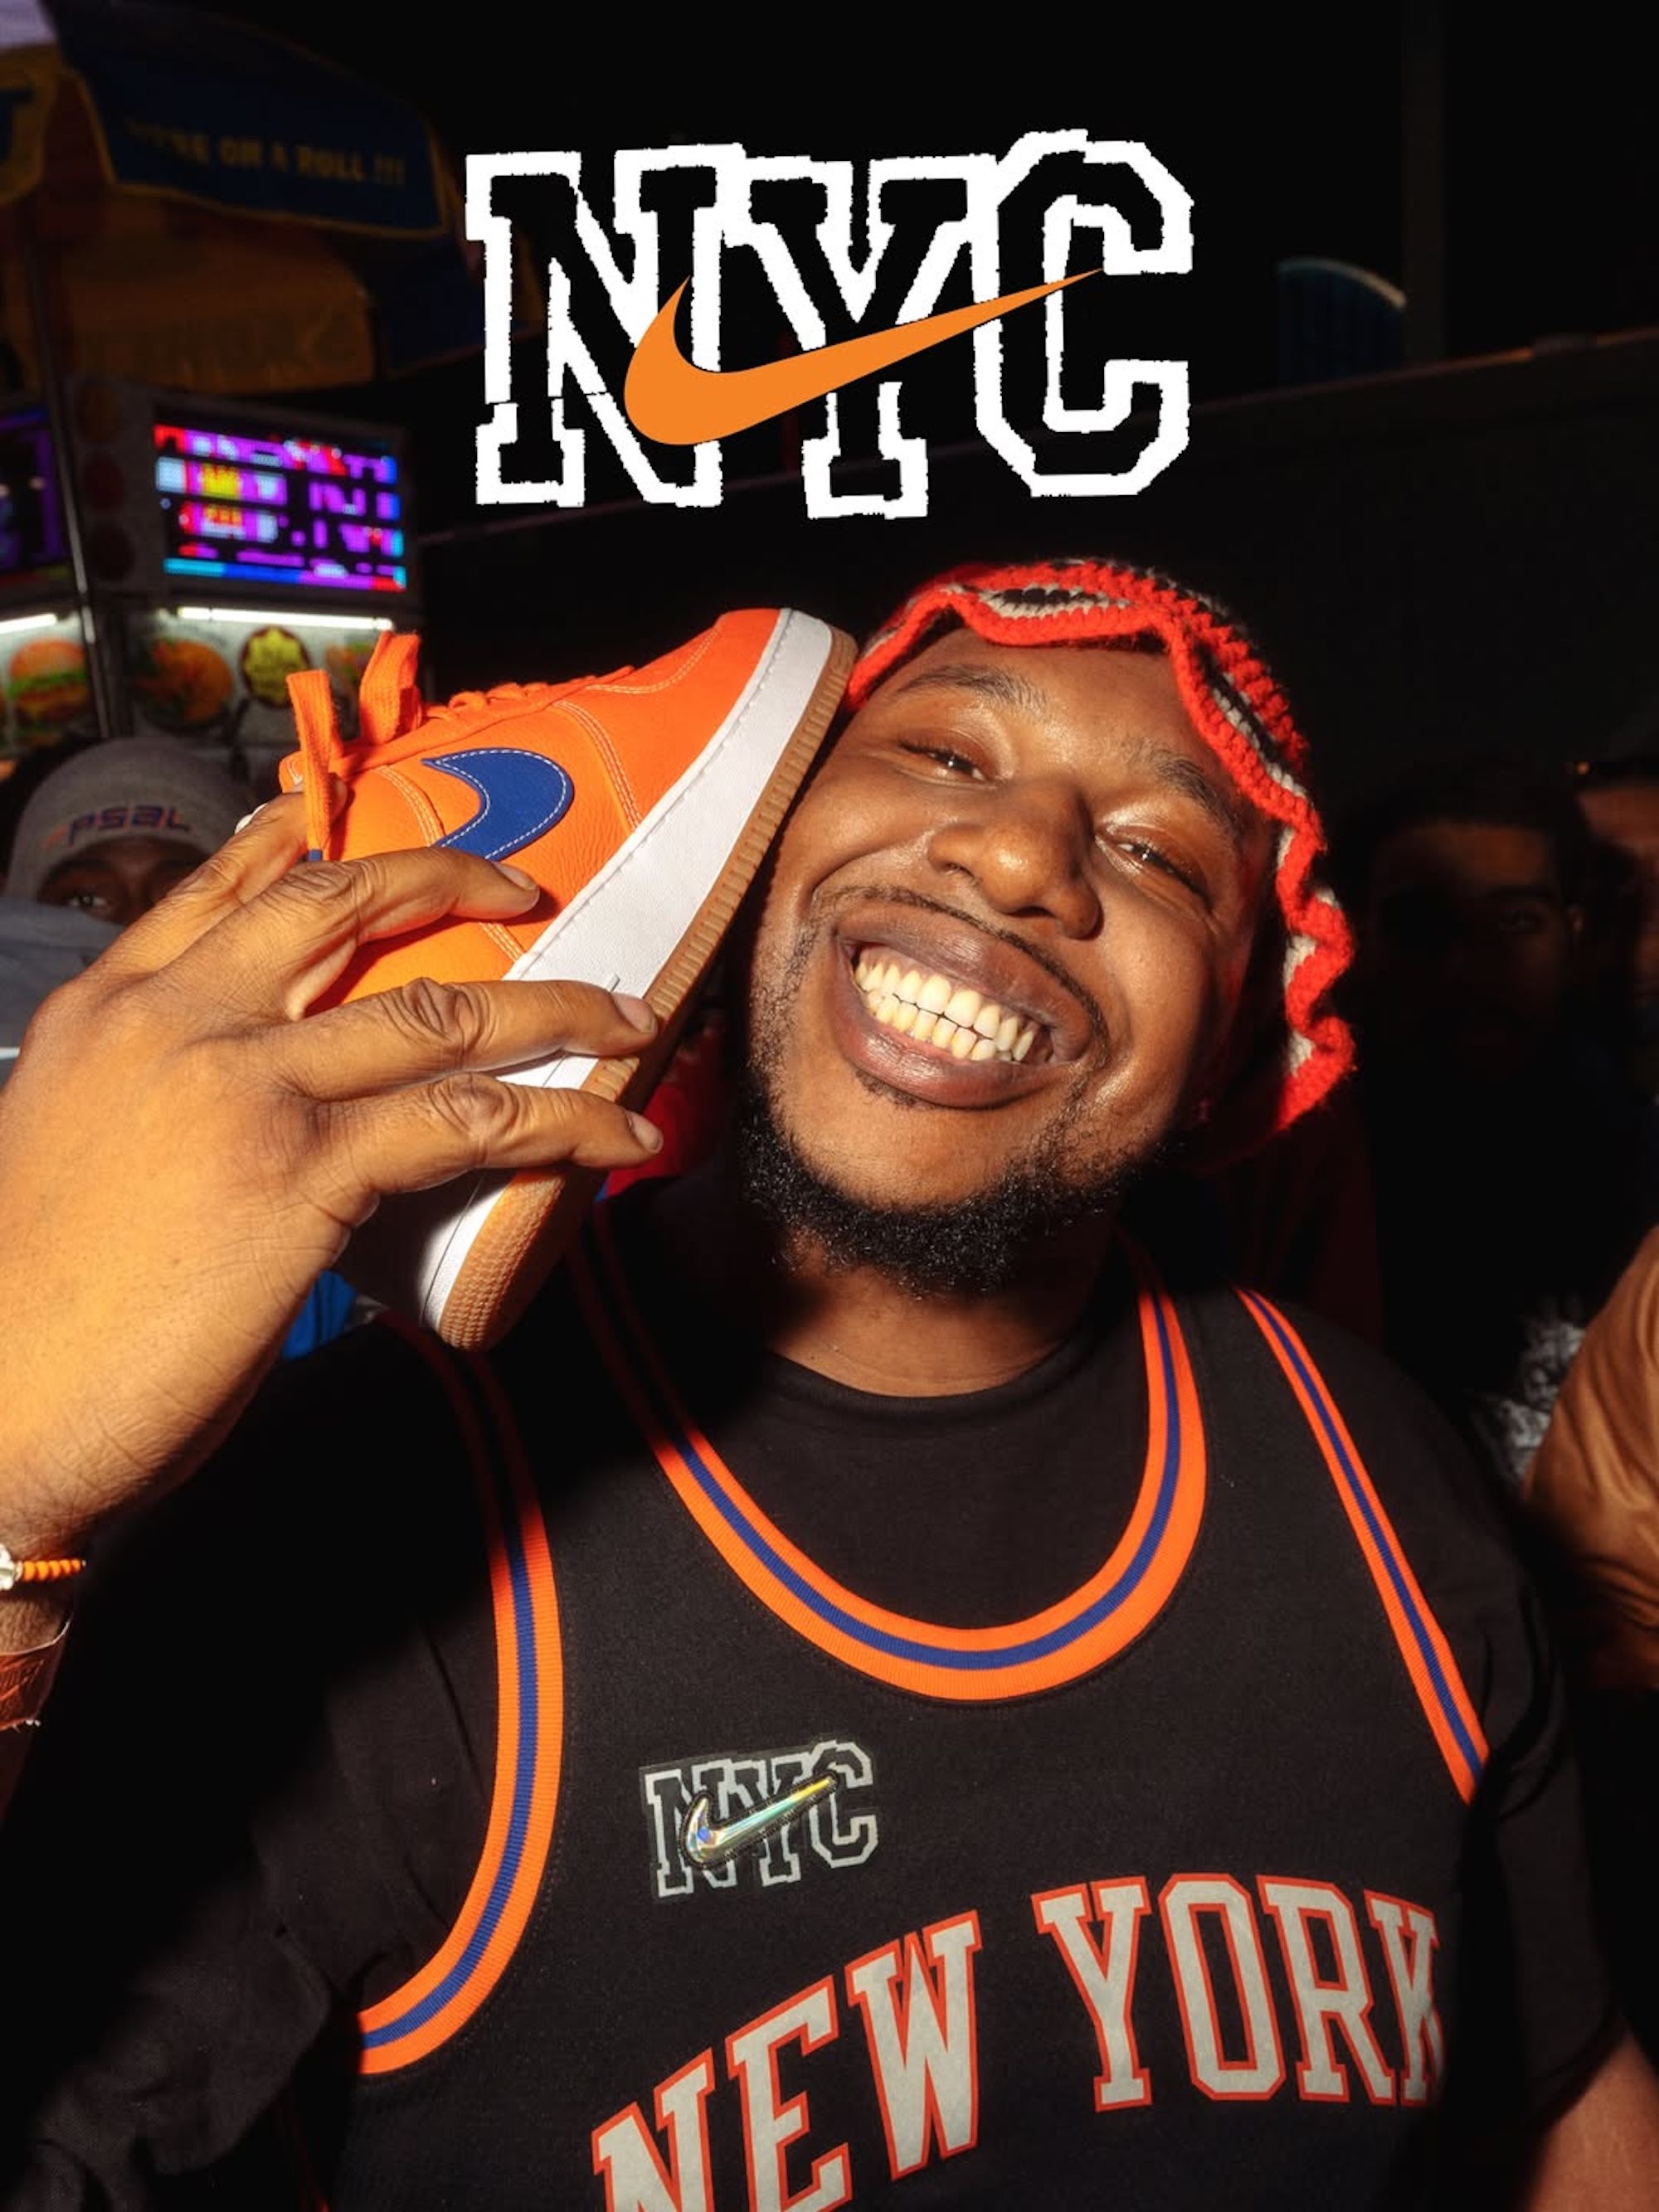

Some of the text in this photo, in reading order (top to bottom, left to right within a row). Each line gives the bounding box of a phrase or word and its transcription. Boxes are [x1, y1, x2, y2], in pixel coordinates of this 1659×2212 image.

[294, 143, 366, 183] ROLL
[645, 1740, 878, 1898] NYC
[591, 1872, 1446, 2212] NEW YORK
